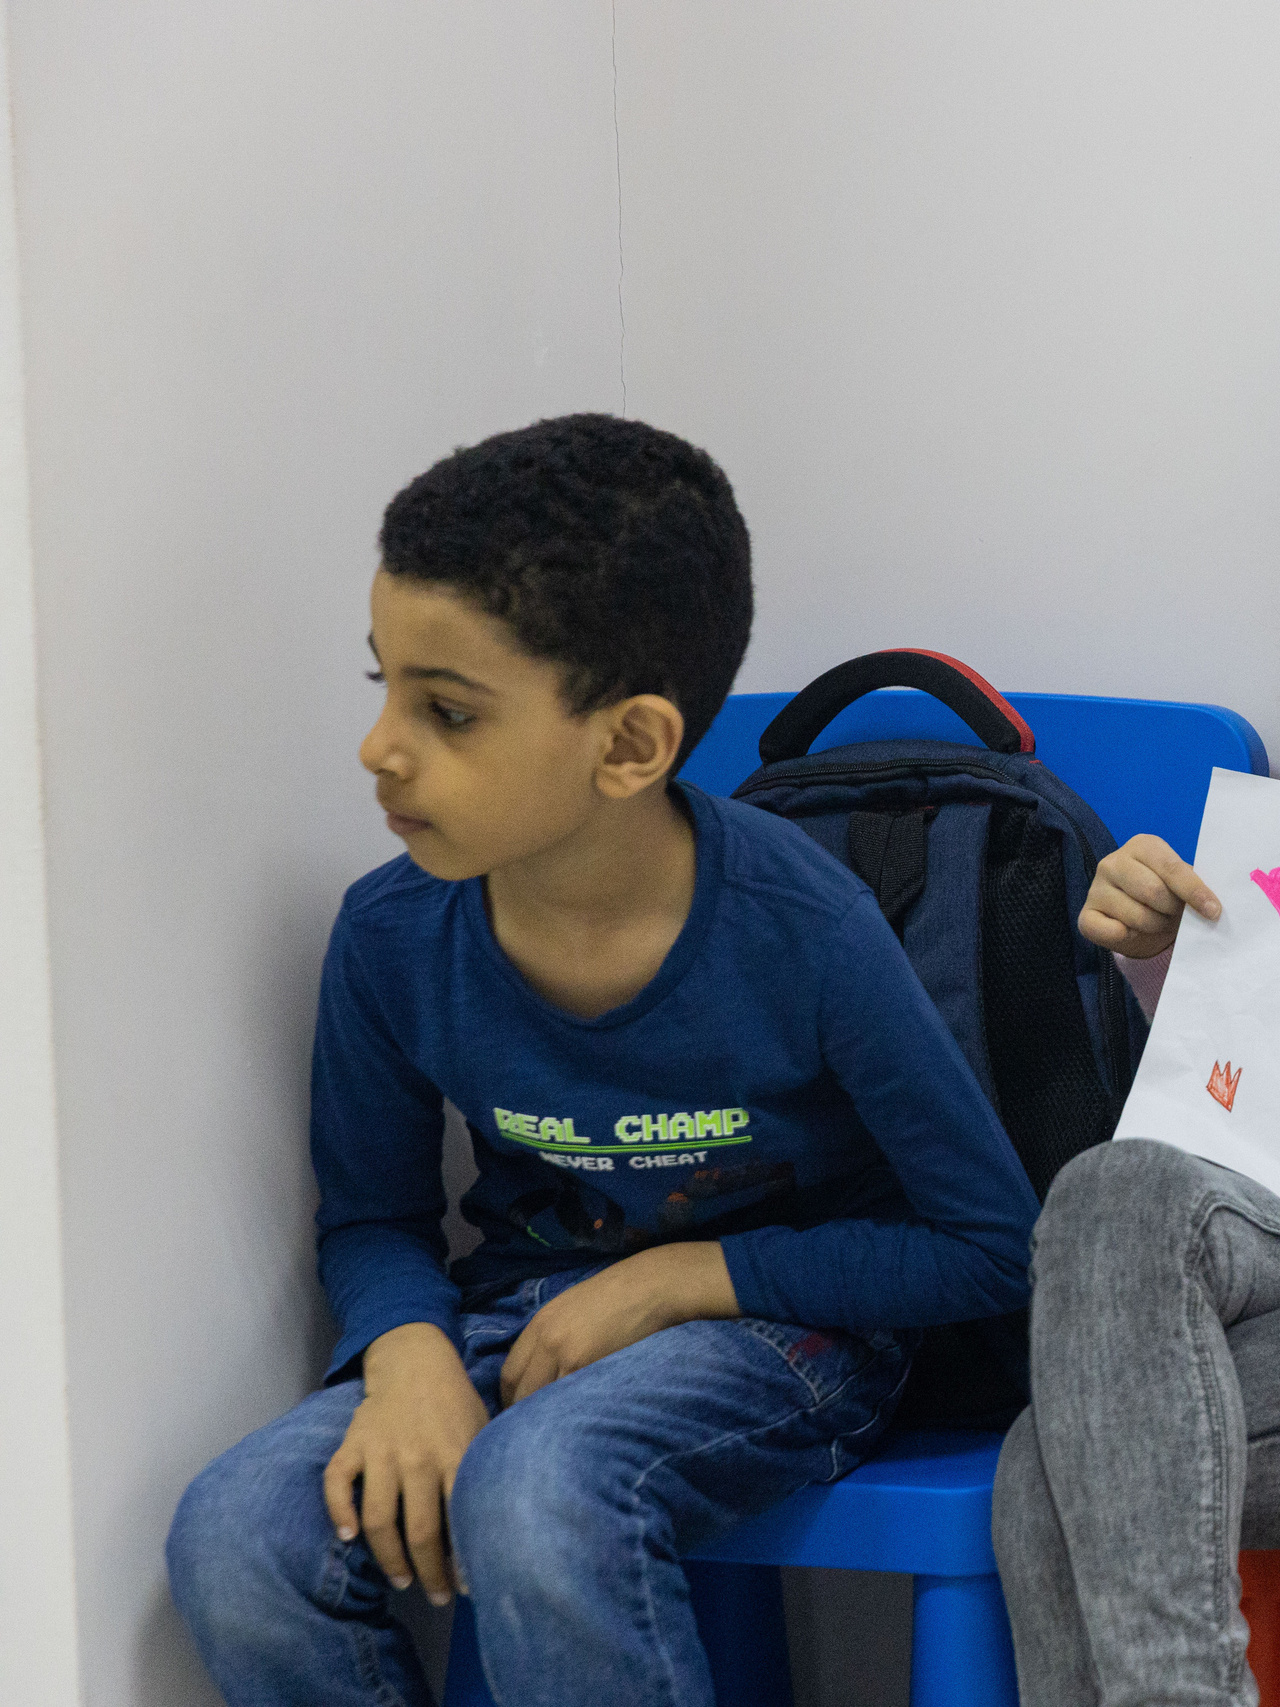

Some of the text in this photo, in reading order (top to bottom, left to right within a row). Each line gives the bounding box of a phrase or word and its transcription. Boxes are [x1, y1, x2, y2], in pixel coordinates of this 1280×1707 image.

[493, 1107, 749, 1144] REAL CHAMP
[629, 1151, 708, 1169] CHEAT
